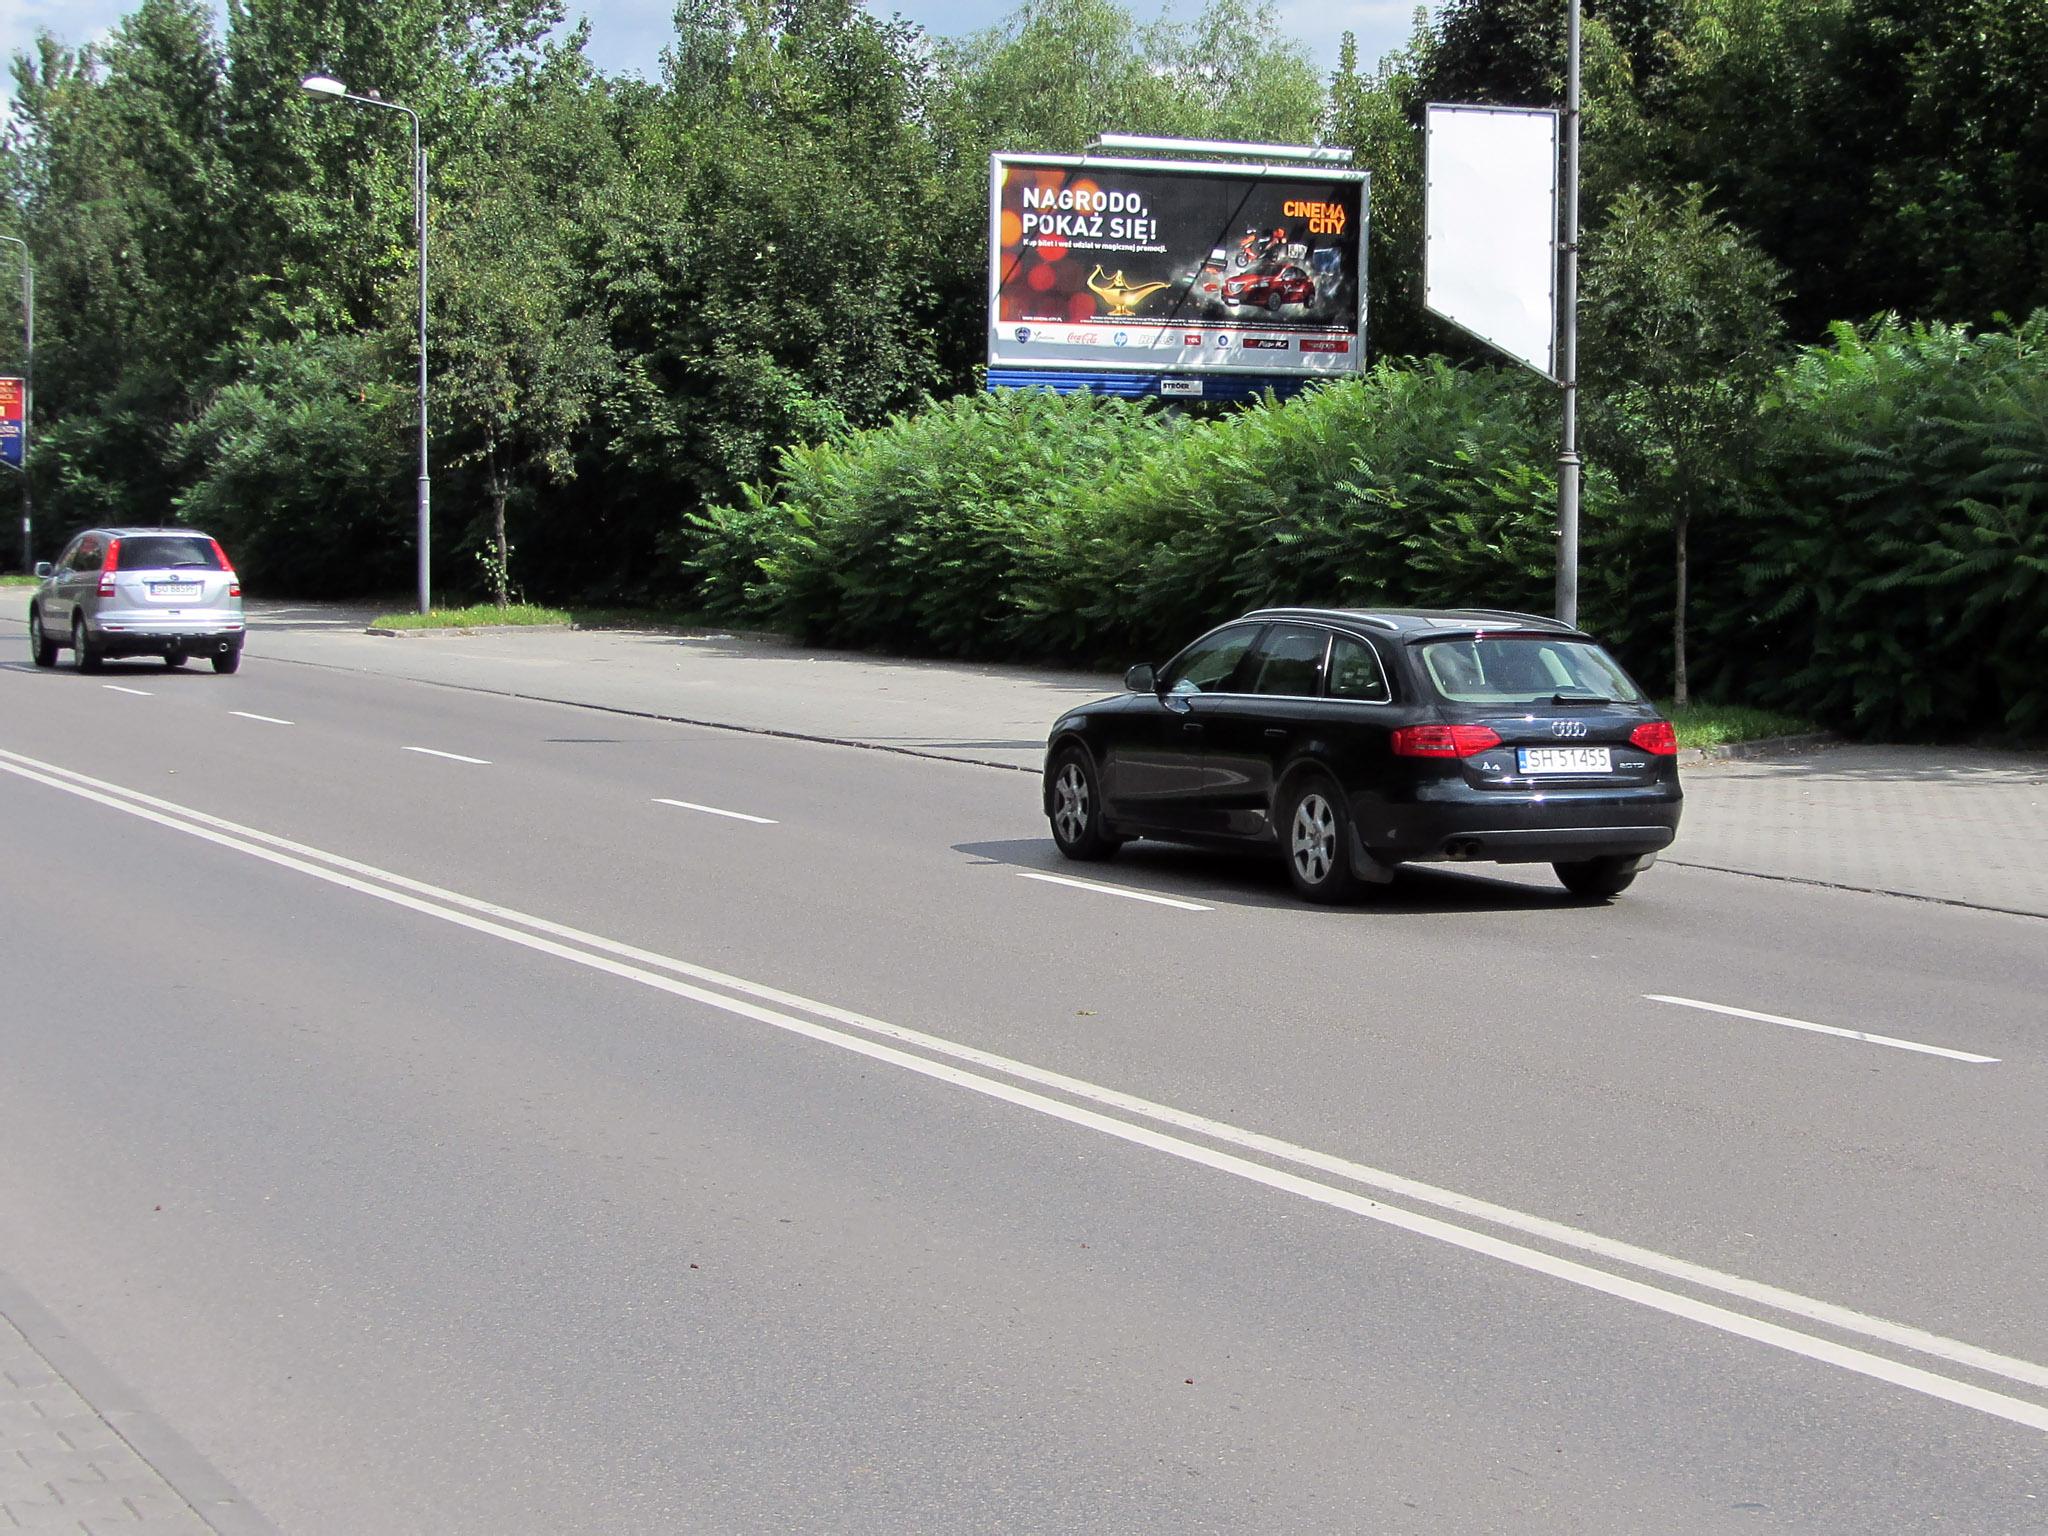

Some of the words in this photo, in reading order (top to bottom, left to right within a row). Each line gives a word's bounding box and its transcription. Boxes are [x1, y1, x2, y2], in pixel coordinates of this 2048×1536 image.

[1023, 187, 1148, 218] NAGRODO,
[1283, 201, 1345, 219] CINEMA
[1022, 212, 1103, 238] POKAŻ
[1110, 218, 1157, 245] SIĘ!
[1309, 218, 1345, 235] CITY
[1038, 239, 1054, 247] bilet
[1102, 243, 1135, 252] magicznej
[1482, 761, 1501, 771] A4
[1529, 749, 1554, 767] SH
[1560, 749, 1608, 767] 51455
